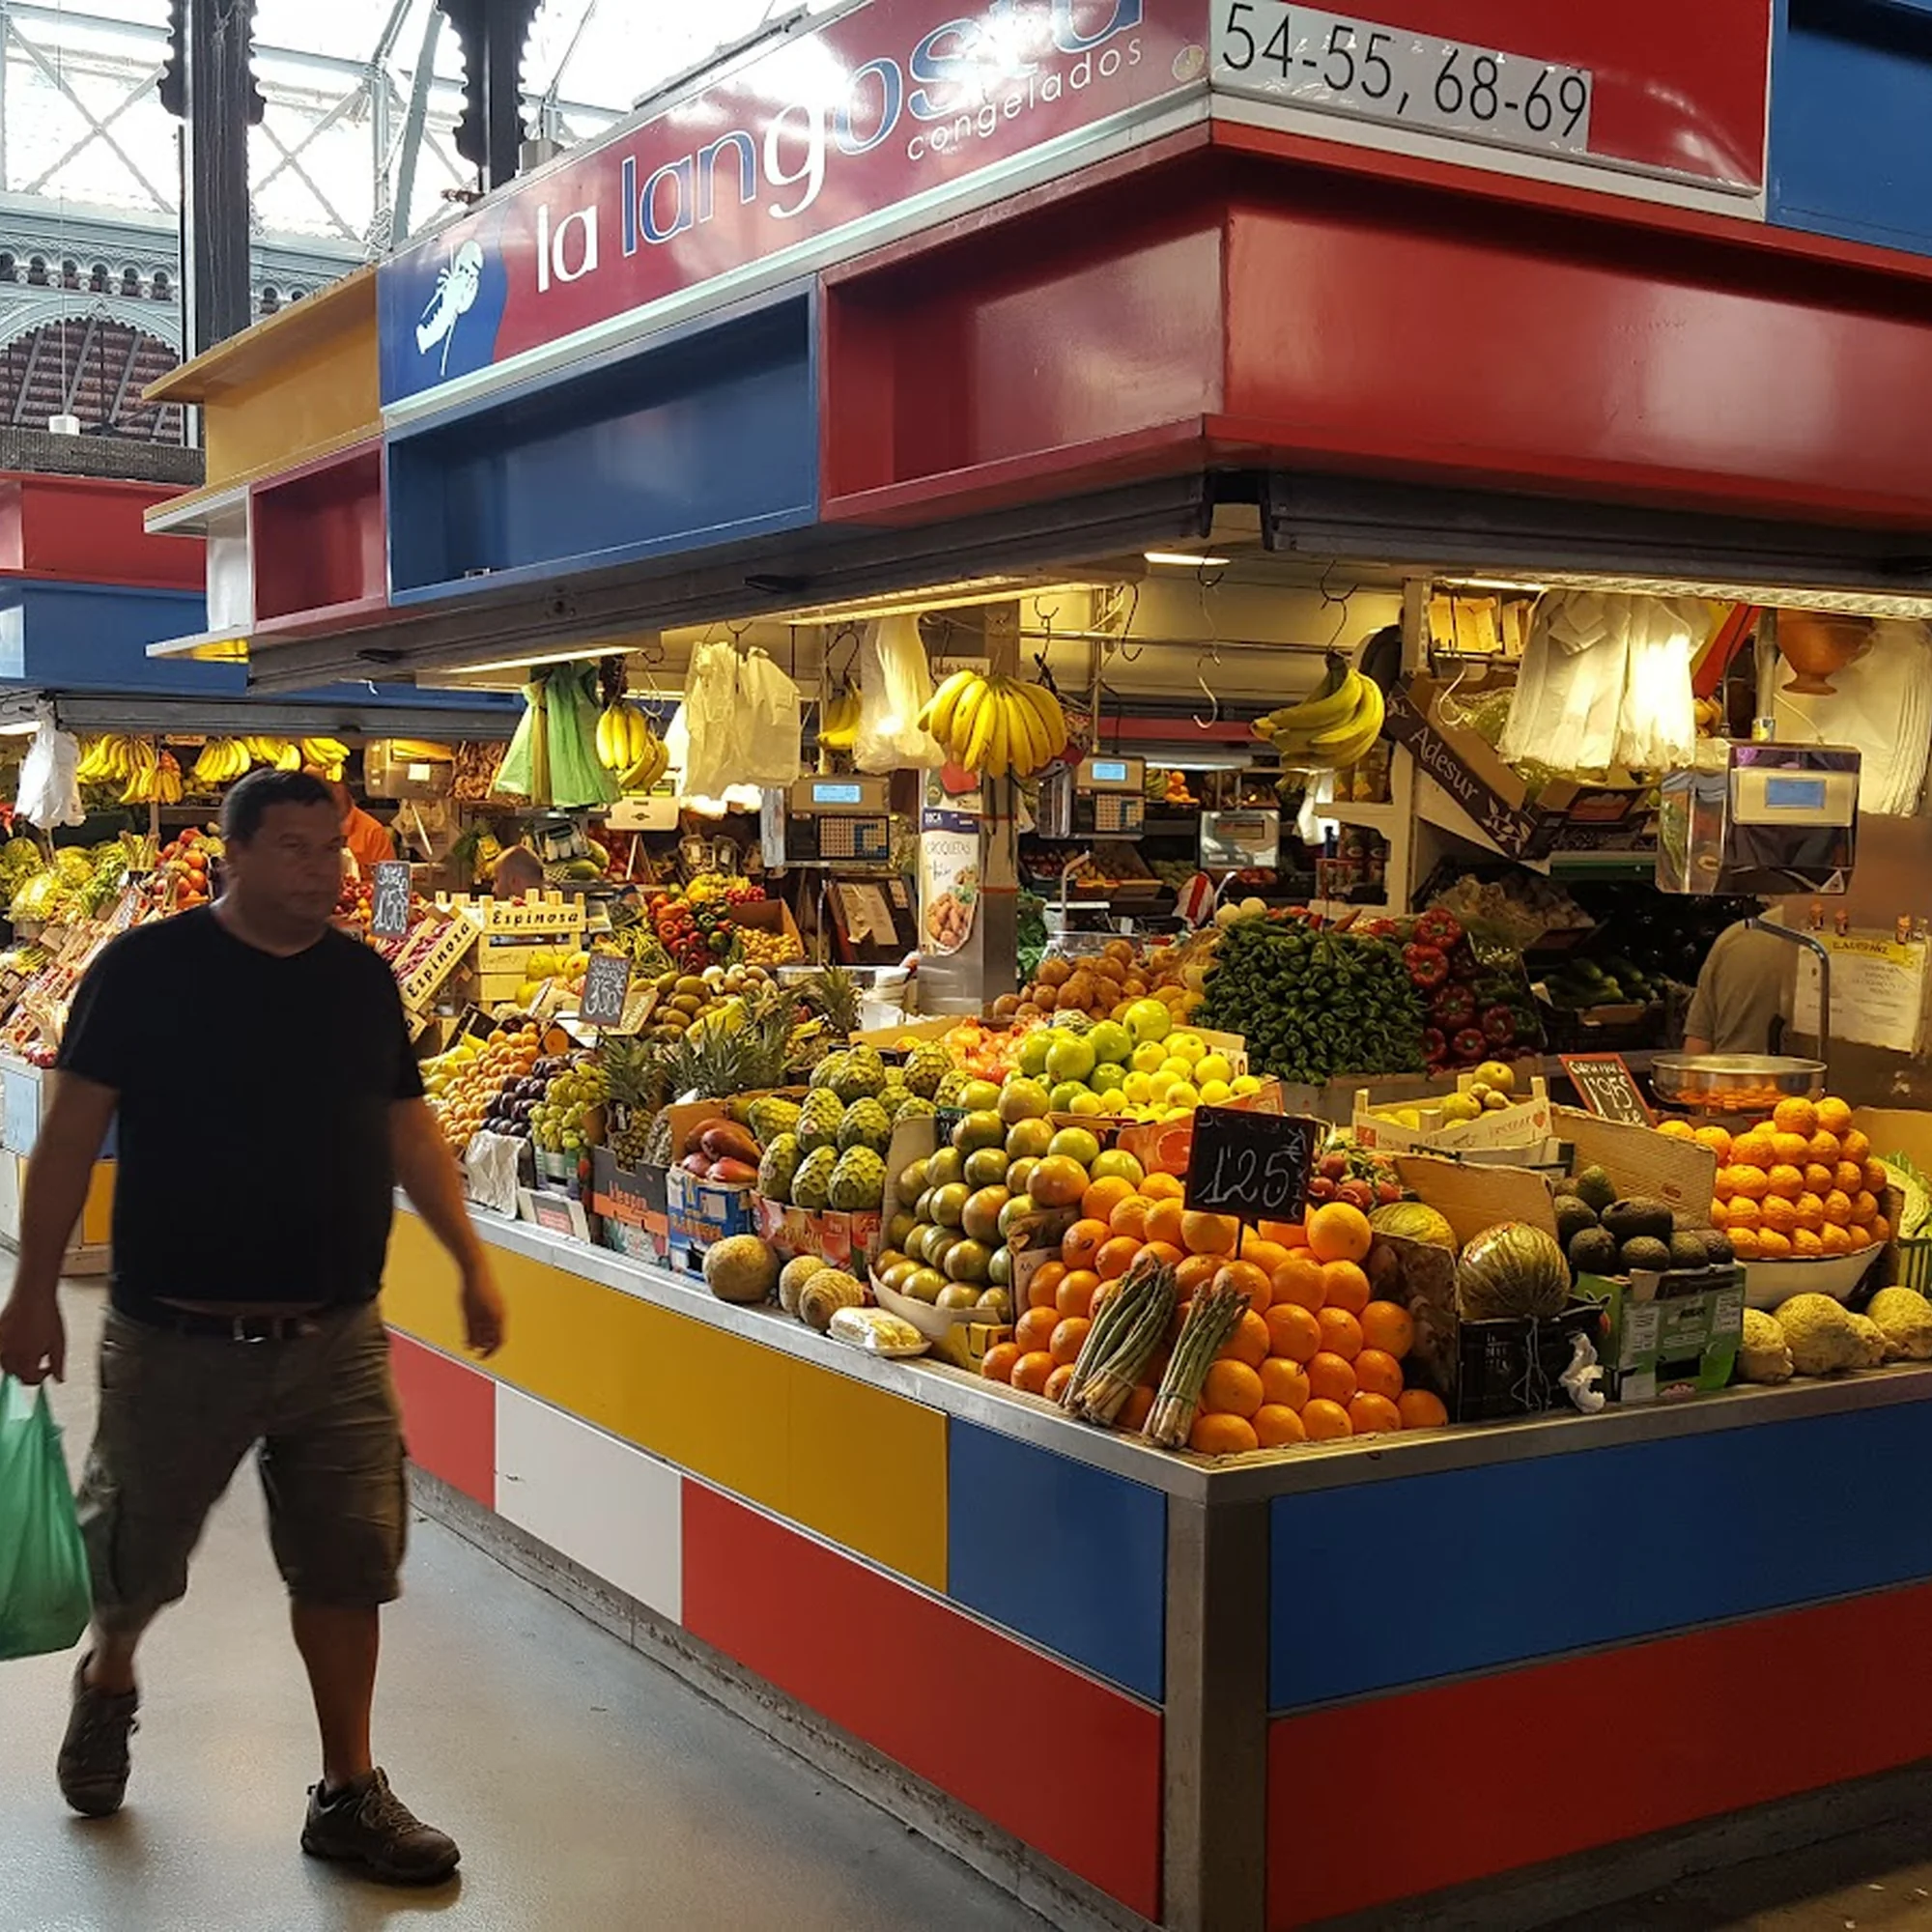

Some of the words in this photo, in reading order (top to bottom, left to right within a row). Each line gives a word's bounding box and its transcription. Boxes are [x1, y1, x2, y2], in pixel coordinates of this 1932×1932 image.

[907, 38, 1143, 161] congelados
[1435, 48, 1588, 139] 68-69
[535, 205, 599, 294] la
[1408, 725, 1479, 800] Adesur
[493, 910, 580, 927] Espinosa
[406, 922, 470, 999] Espinosa
